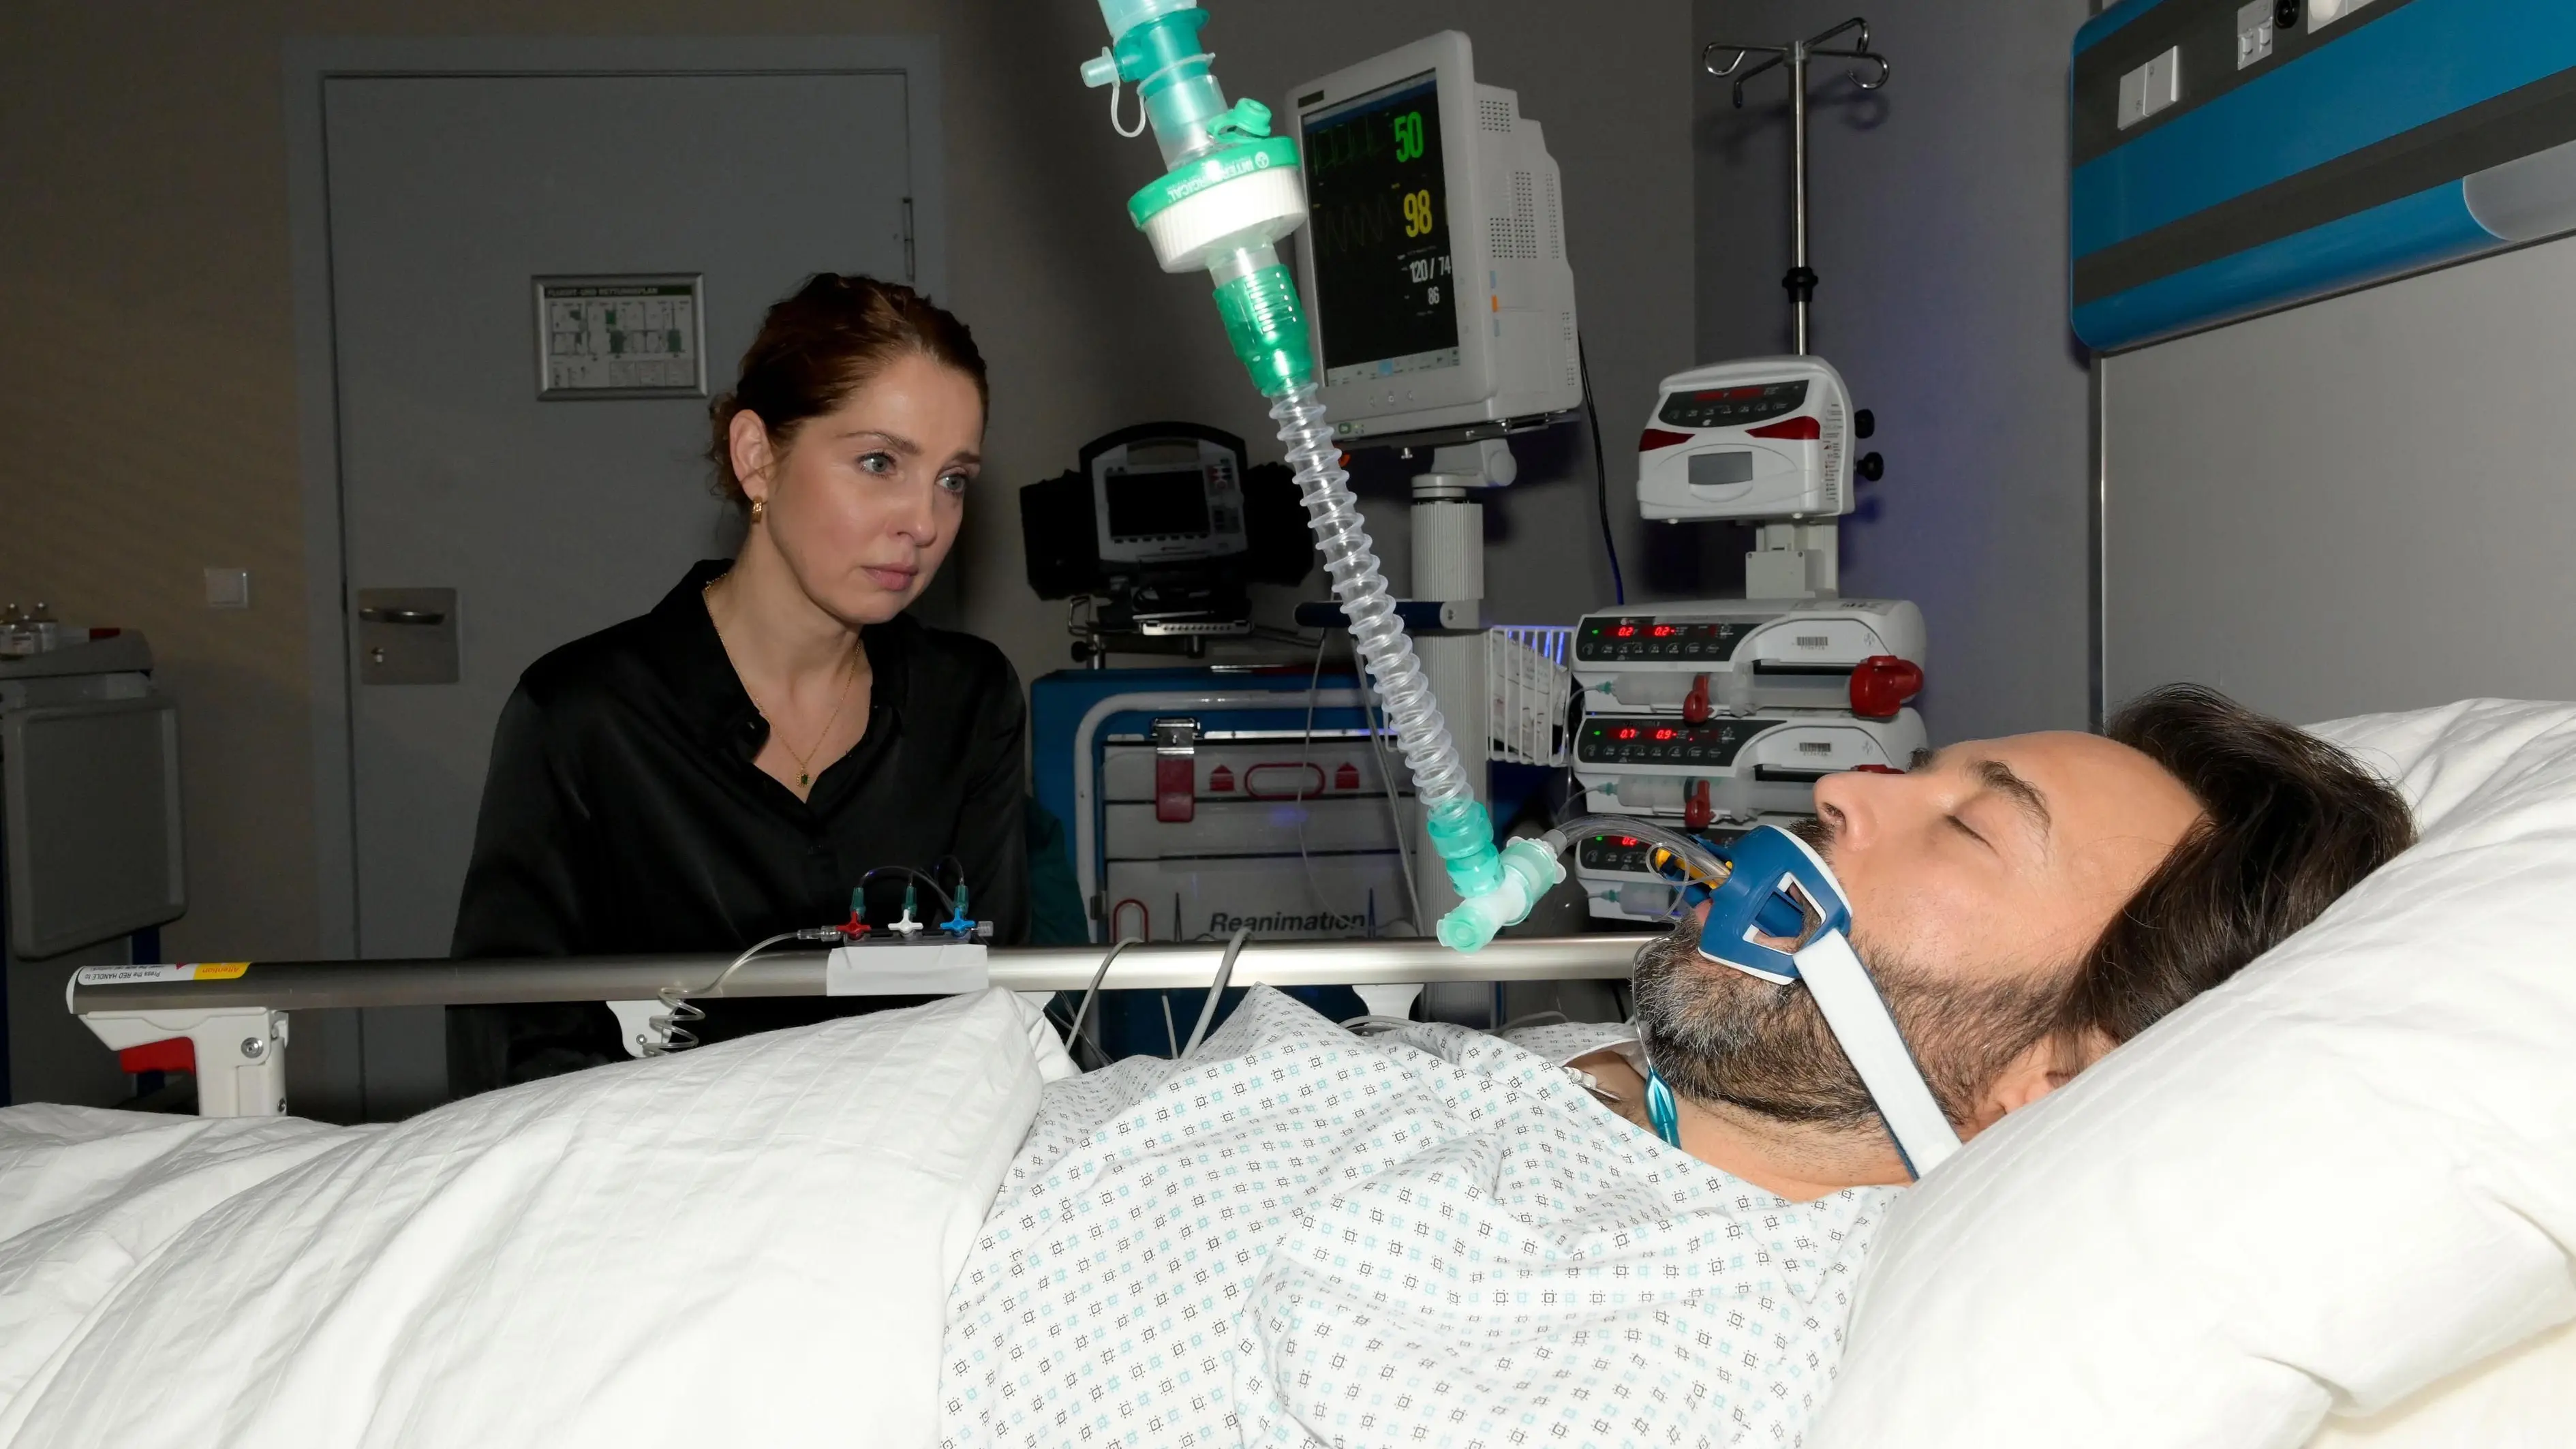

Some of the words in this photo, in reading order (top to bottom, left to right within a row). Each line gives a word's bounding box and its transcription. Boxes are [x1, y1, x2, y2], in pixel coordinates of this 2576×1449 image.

[1394, 111, 1424, 162] 50
[1404, 189, 1432, 238] 98
[1409, 259, 1428, 283] 120
[1438, 256, 1451, 276] 74
[1428, 286, 1439, 305] 86
[1619, 626, 1634, 637] 0.2
[1654, 626, 1669, 637] 0.2
[1210, 911, 1365, 933] Reanimation
[202, 966, 240, 974] Attention
